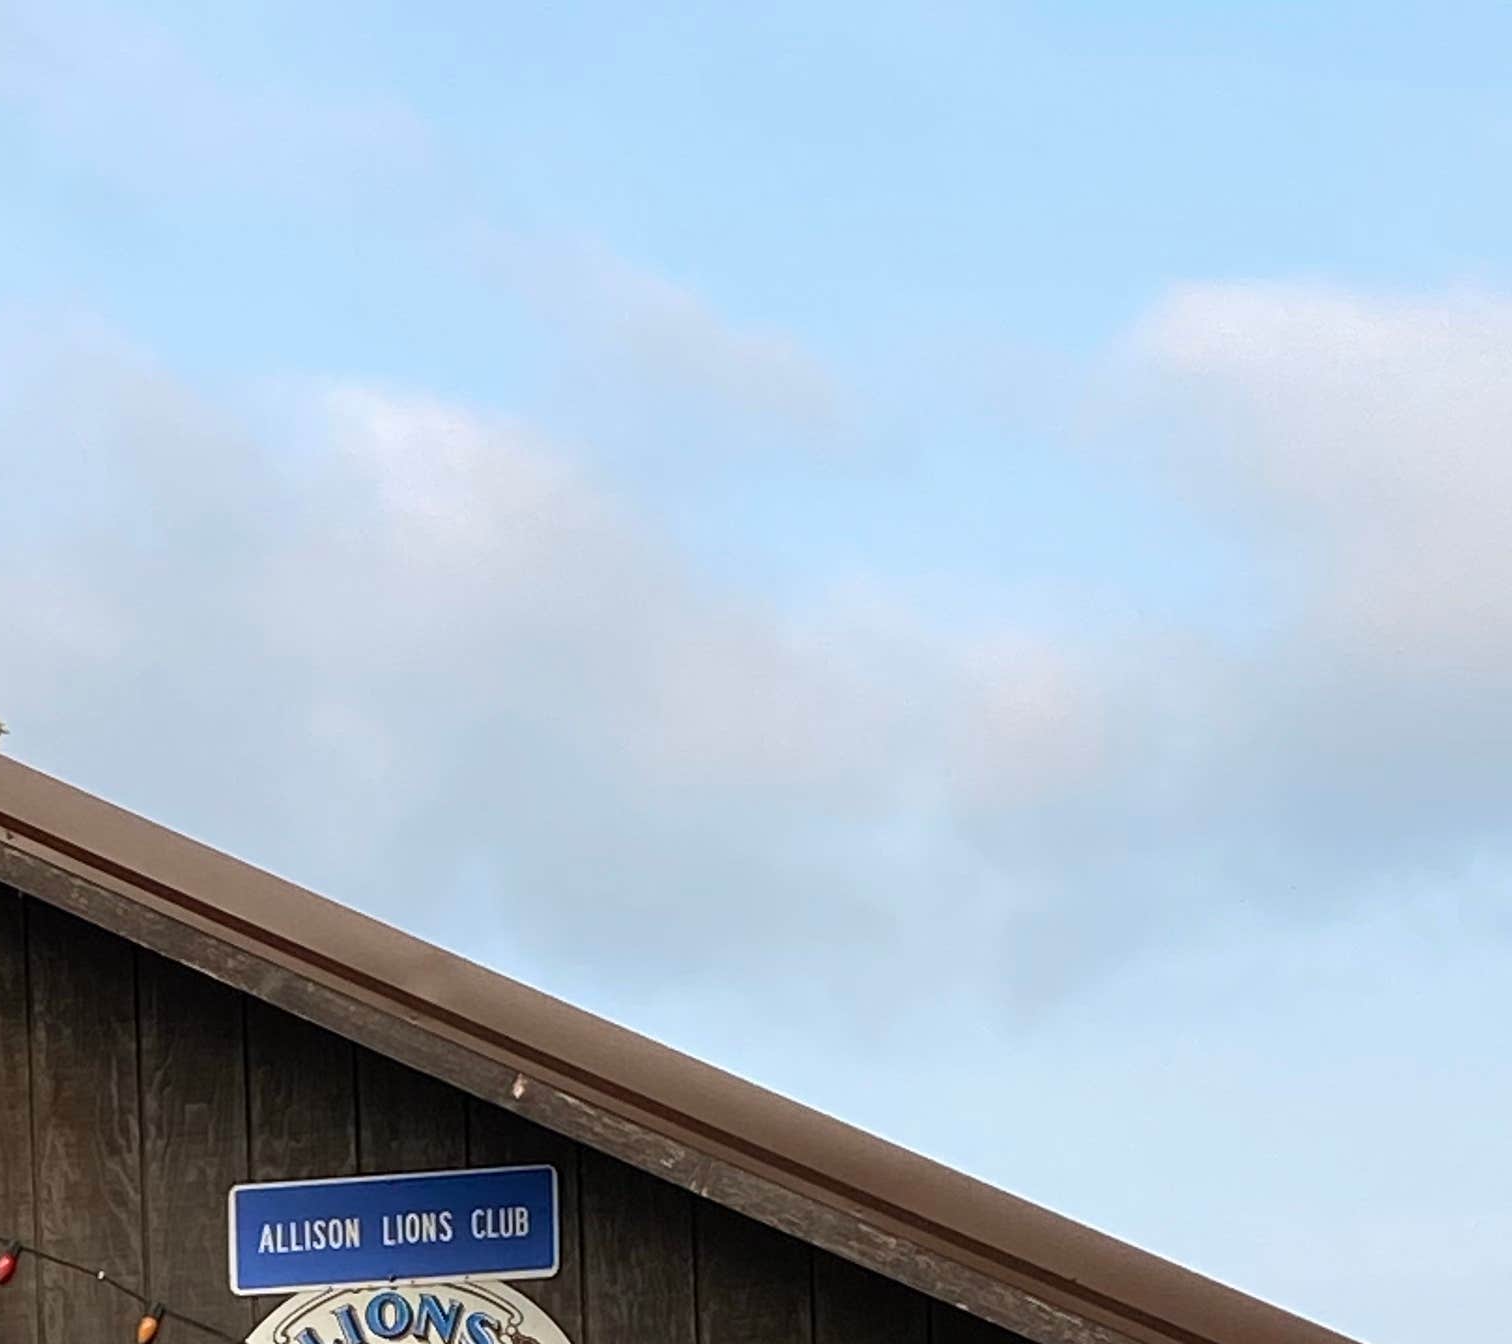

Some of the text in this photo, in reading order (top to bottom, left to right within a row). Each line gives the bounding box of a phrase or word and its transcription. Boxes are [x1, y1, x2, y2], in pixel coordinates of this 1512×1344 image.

[257, 1206, 530, 1254] ALLISON LIONS CLUB
